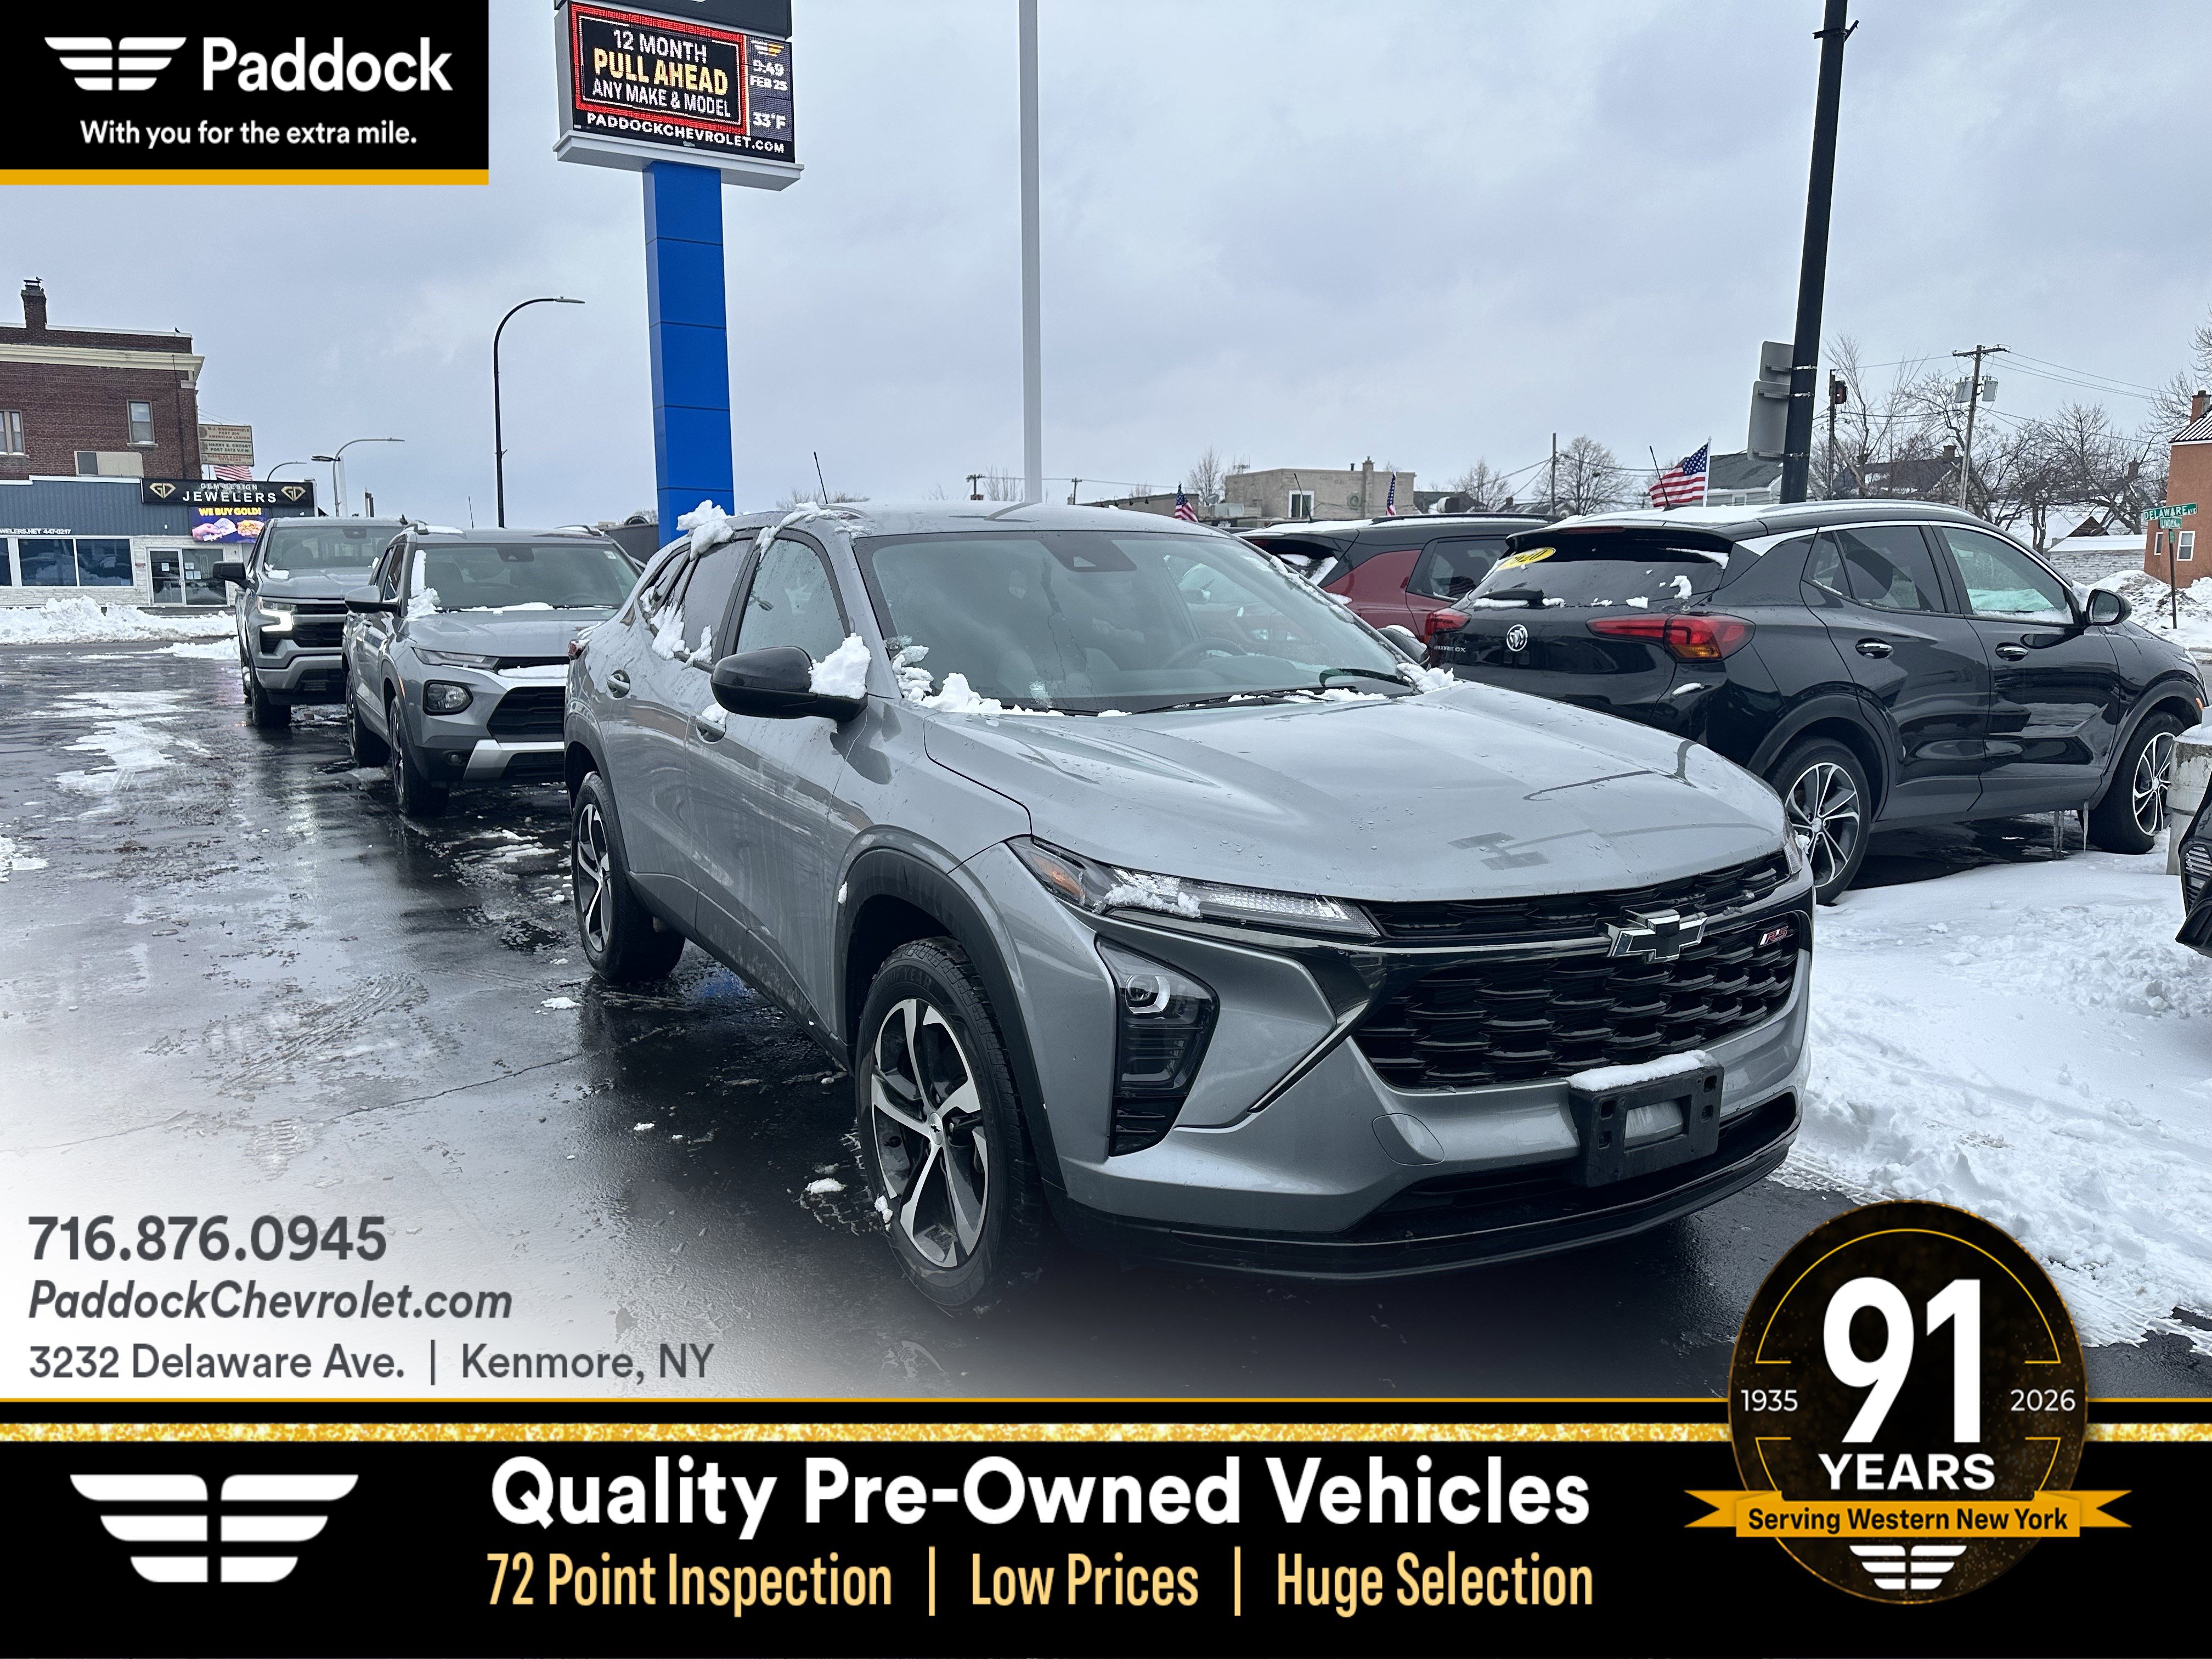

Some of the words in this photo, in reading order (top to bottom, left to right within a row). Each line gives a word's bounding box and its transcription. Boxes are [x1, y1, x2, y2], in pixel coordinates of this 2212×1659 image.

[613, 29, 634, 51] 12
[640, 33, 707, 64] MONTH
[594, 47, 650, 83] PULL
[653, 59, 728, 96] AHEAD
[750, 75, 772, 88] FEB
[773, 79, 787, 91] 25
[592, 78, 622, 100] ANY
[626, 83, 668, 106] MAKE
[670, 91, 681, 109] &
[684, 93, 731, 117] MODEL
[587, 112, 785, 154] PADDOCKCHEVROLET.COM
[182, 491, 276, 503] JEWELERS
[199, 508, 213, 516] WE
[215, 508, 233, 516] BUY
[234, 507, 262, 516] GOLD!
[2144, 506, 2187, 520] DELAWARE
[1760, 926, 1788, 945] RS
